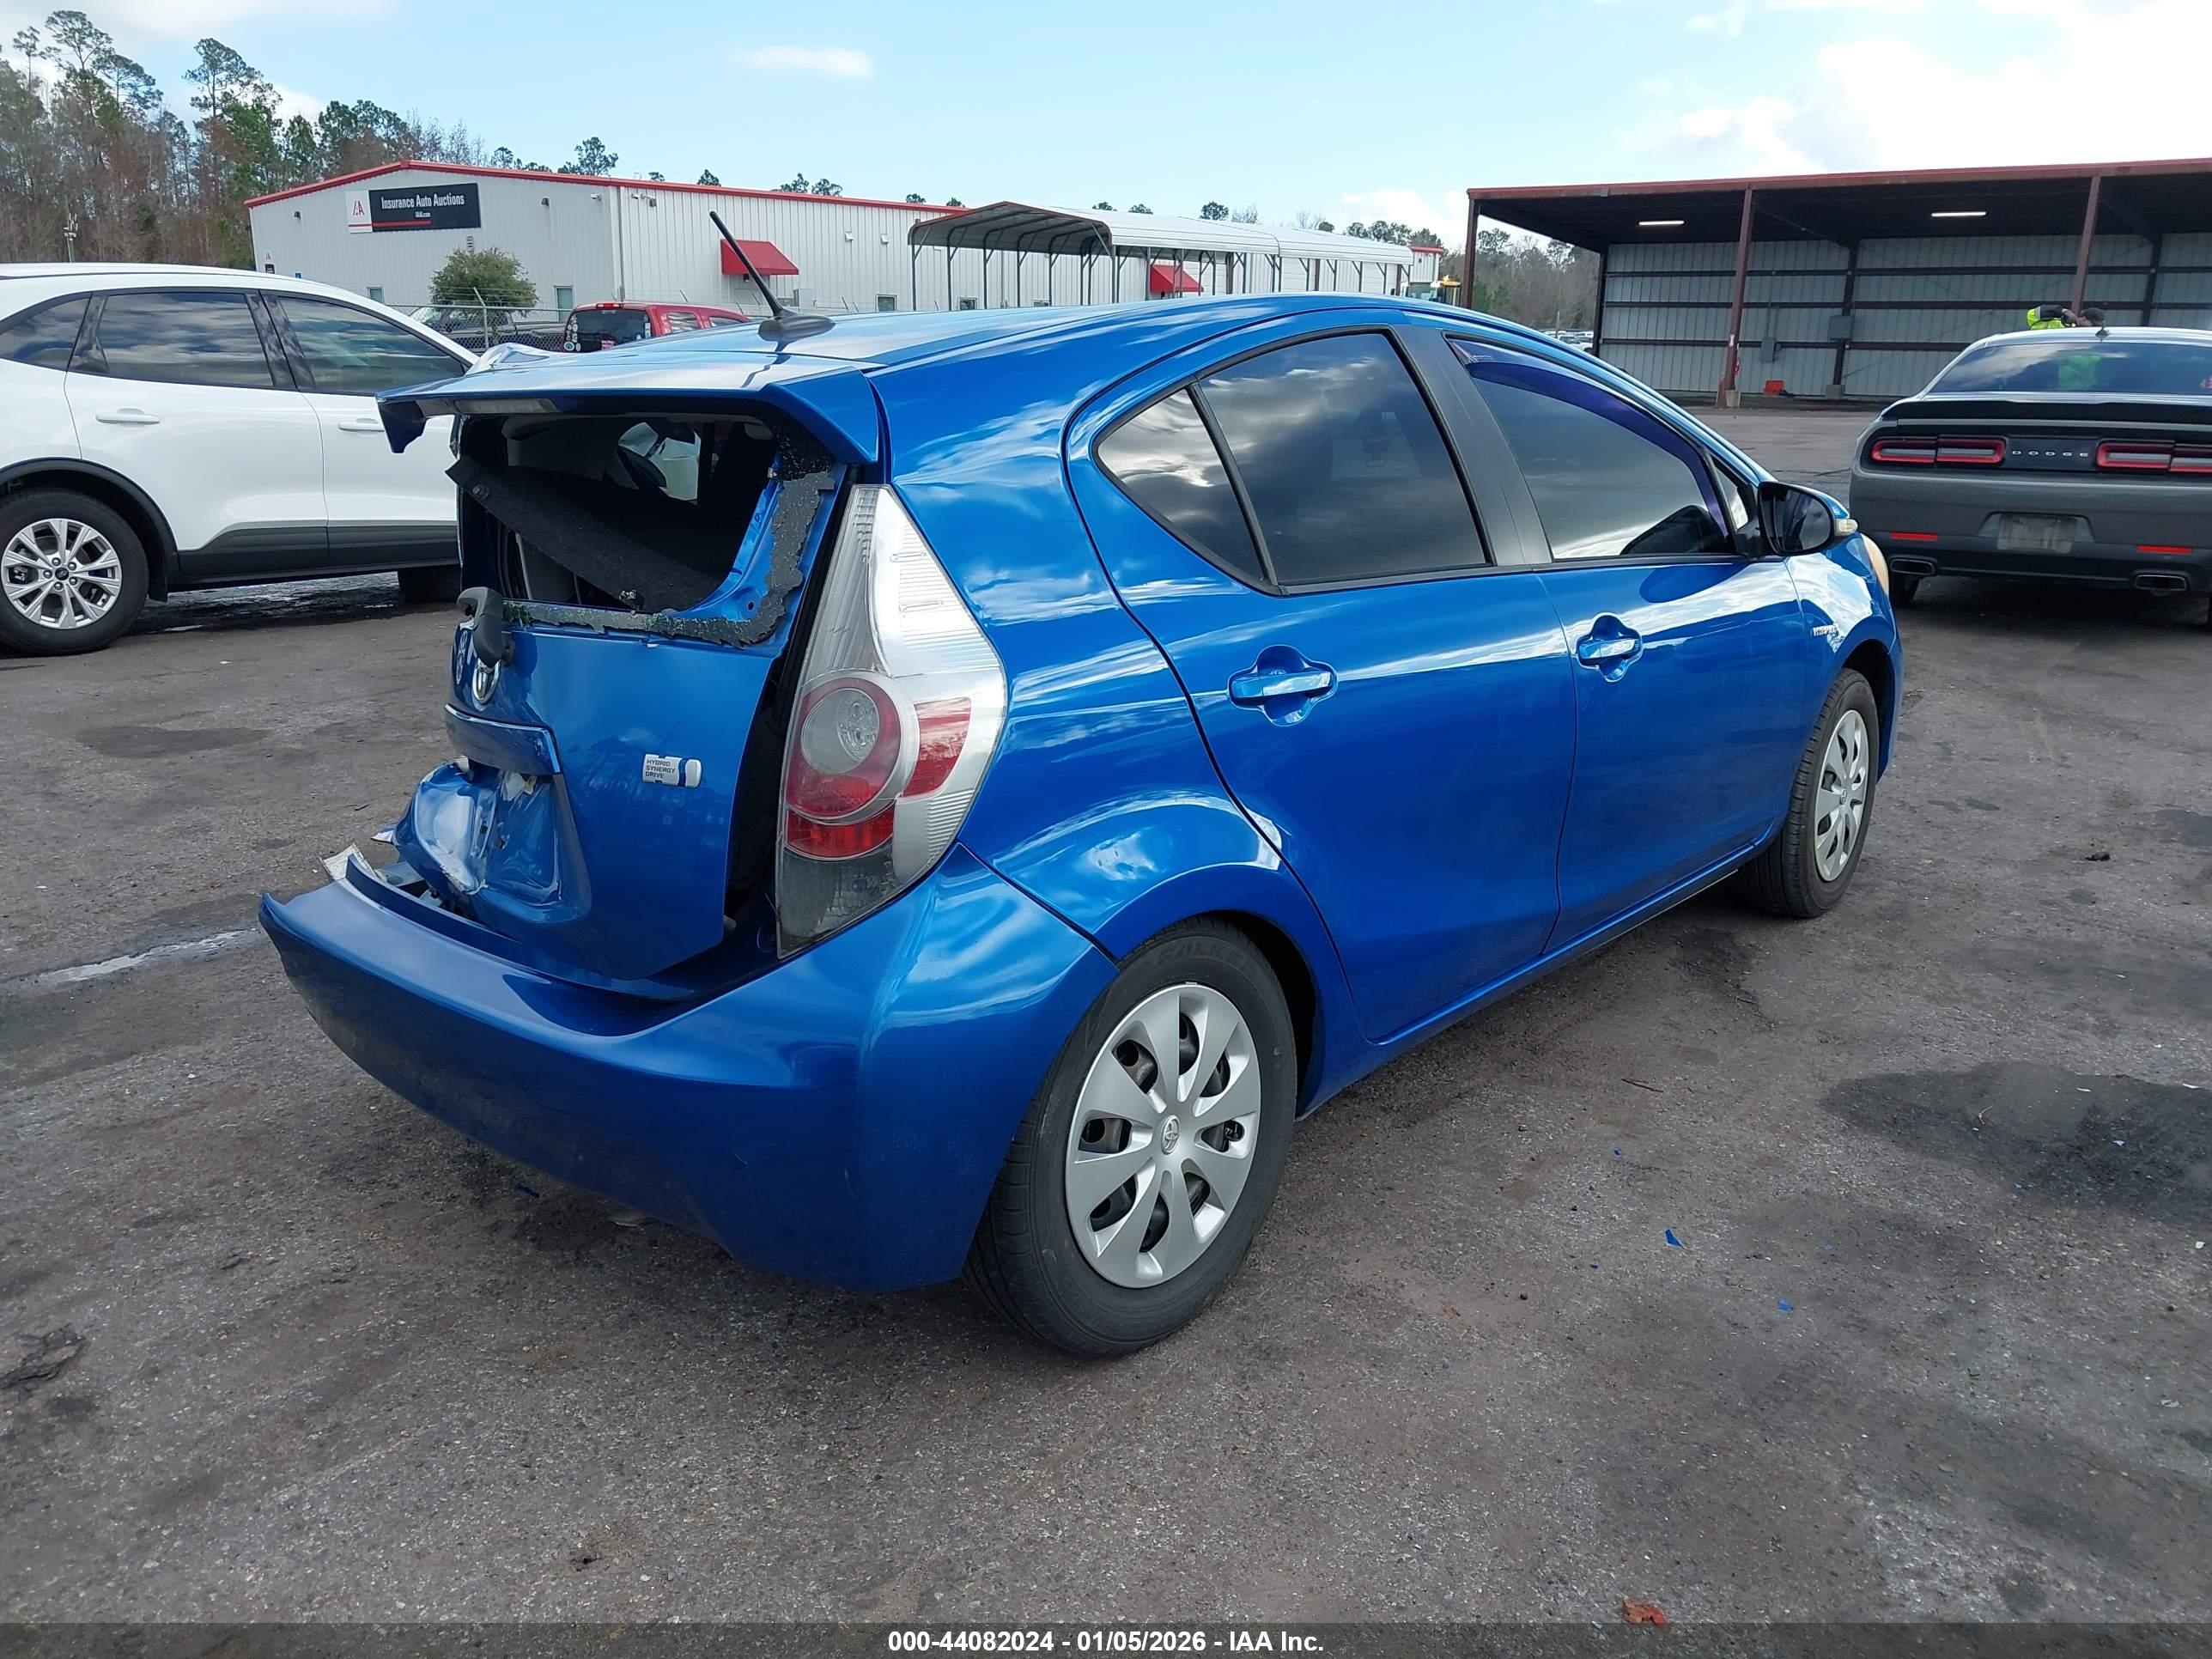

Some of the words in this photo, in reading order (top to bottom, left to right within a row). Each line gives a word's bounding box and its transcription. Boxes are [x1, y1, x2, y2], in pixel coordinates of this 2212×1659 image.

[380, 196, 415, 210] Insurance
[416, 194, 432, 207] Auto
[433, 192, 465, 206] Auctions
[646, 765, 676, 774] SYNERGY
